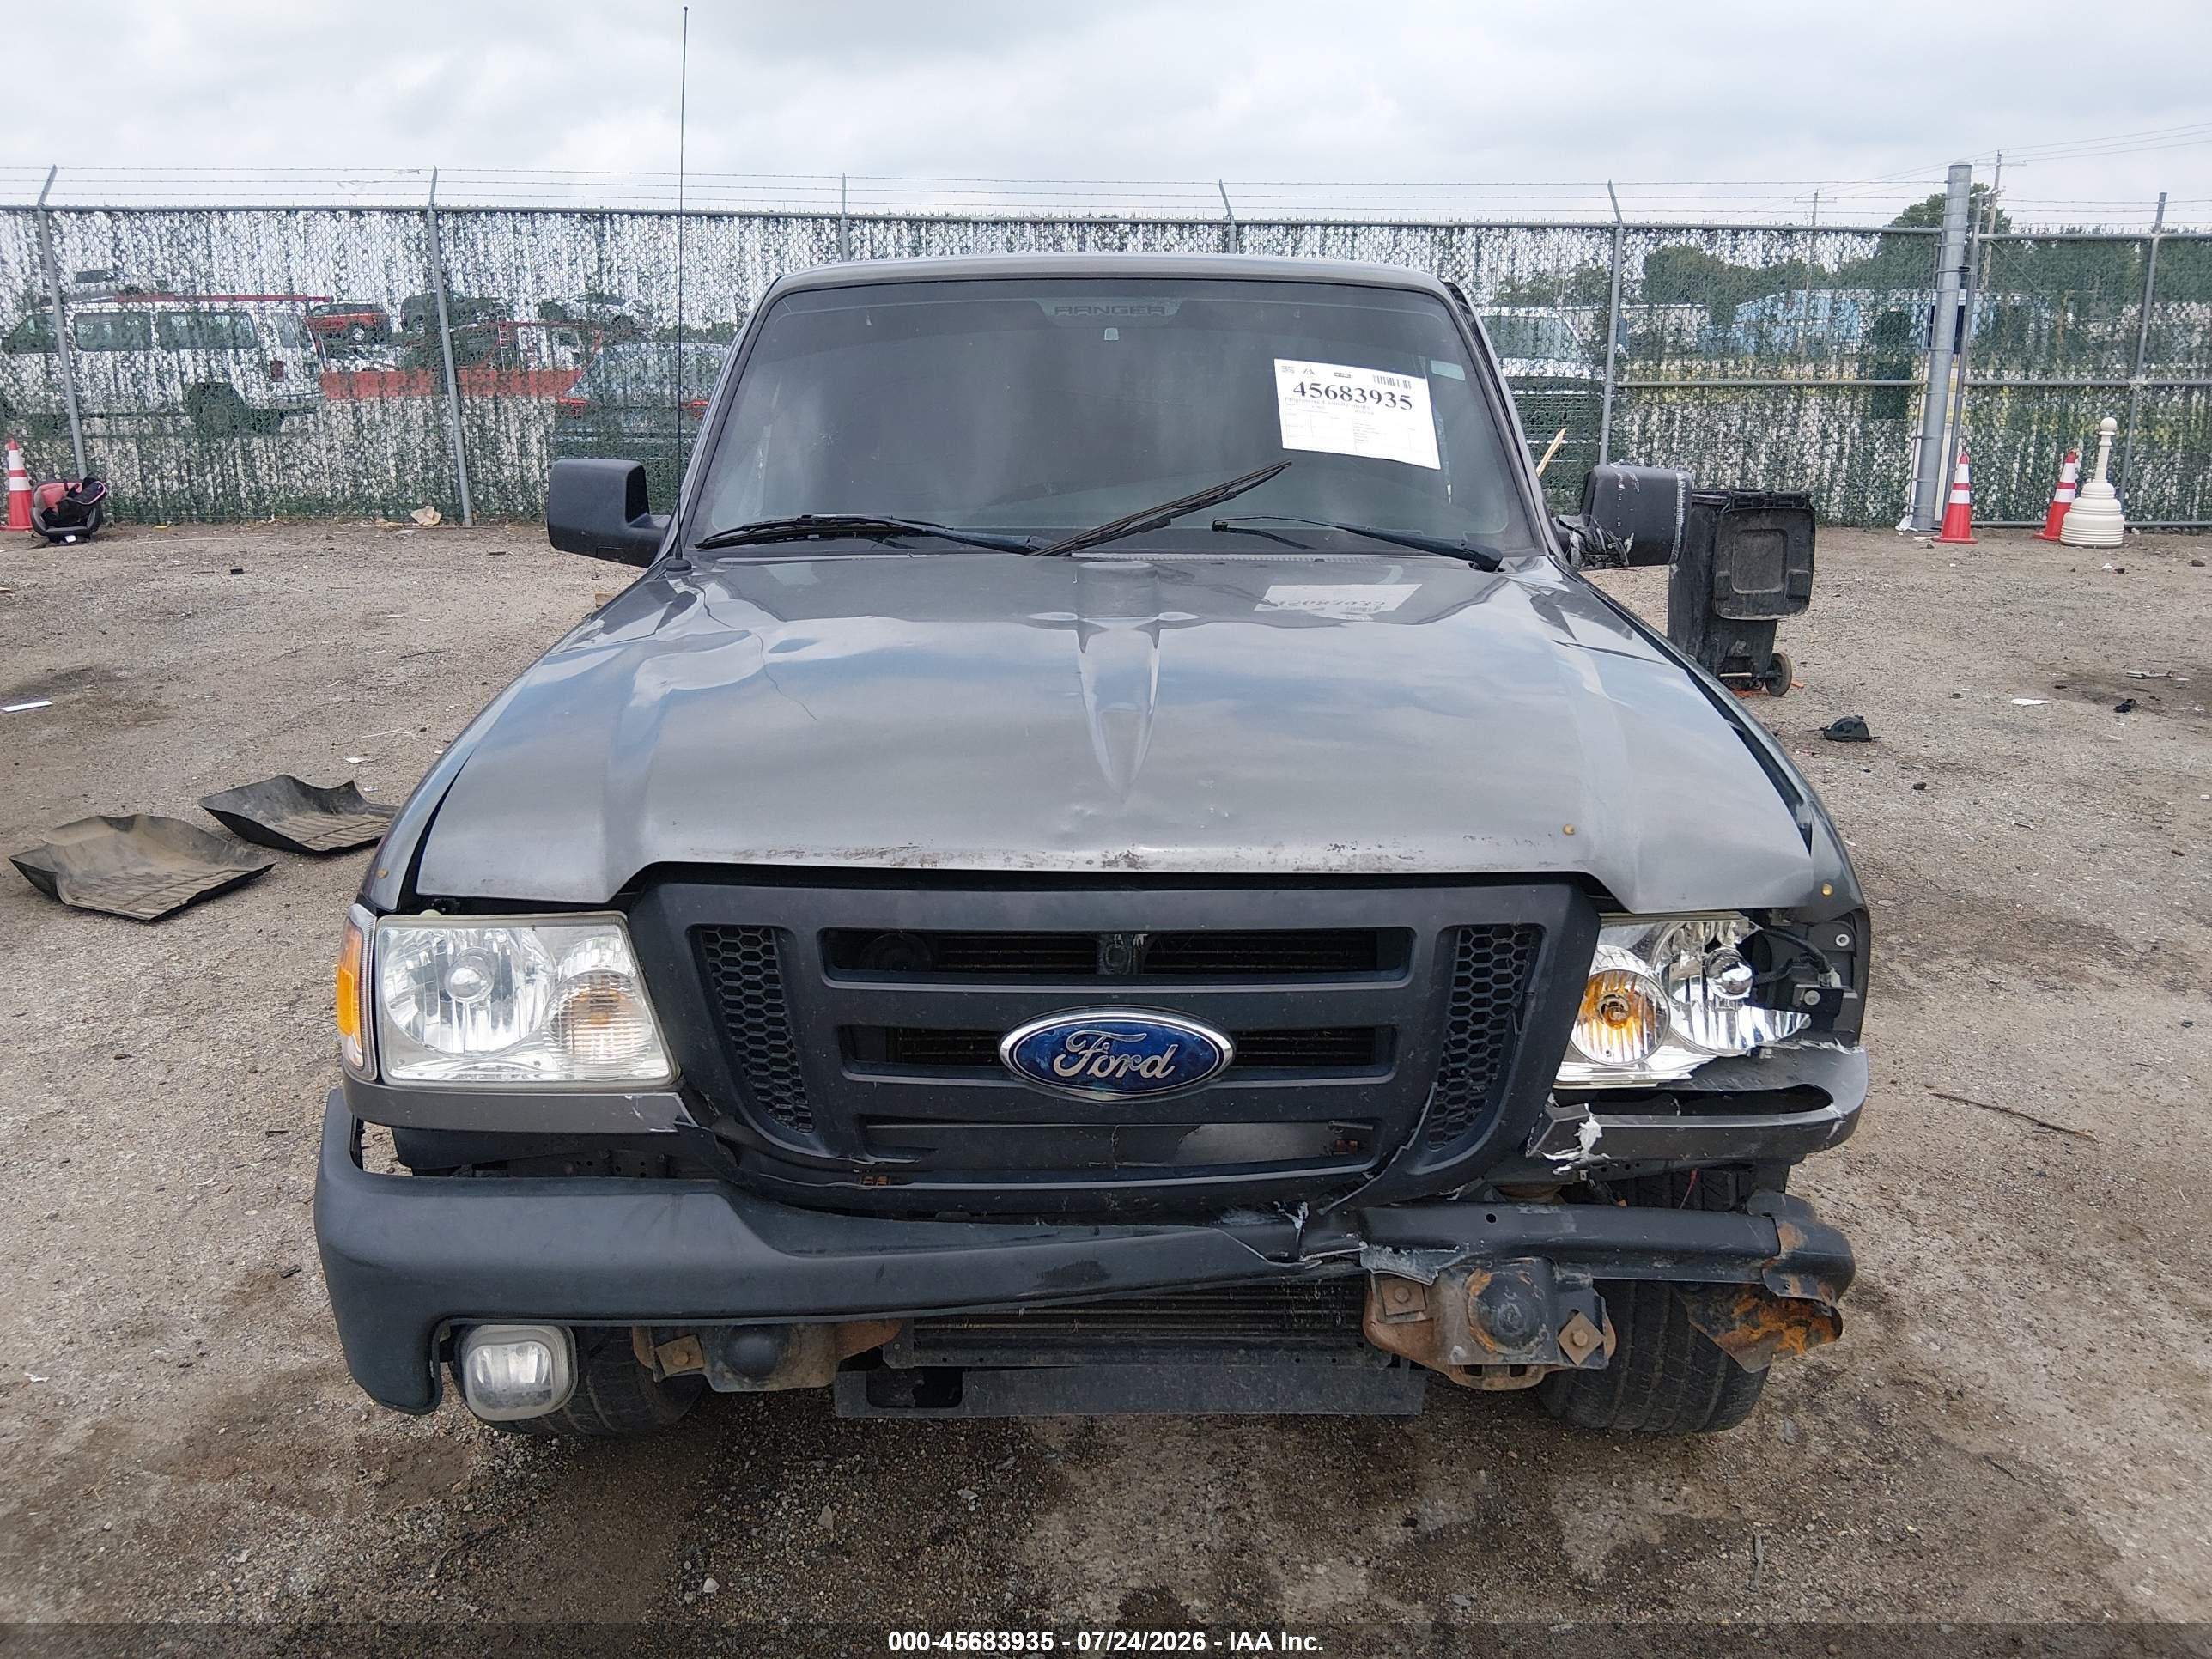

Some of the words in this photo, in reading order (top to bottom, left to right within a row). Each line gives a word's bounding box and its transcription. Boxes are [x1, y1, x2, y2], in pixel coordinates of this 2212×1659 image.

[1054, 305, 1166, 316] RANGER
[1293, 380, 1413, 411] 45683935
[1053, 1030, 1179, 1079] Ford
